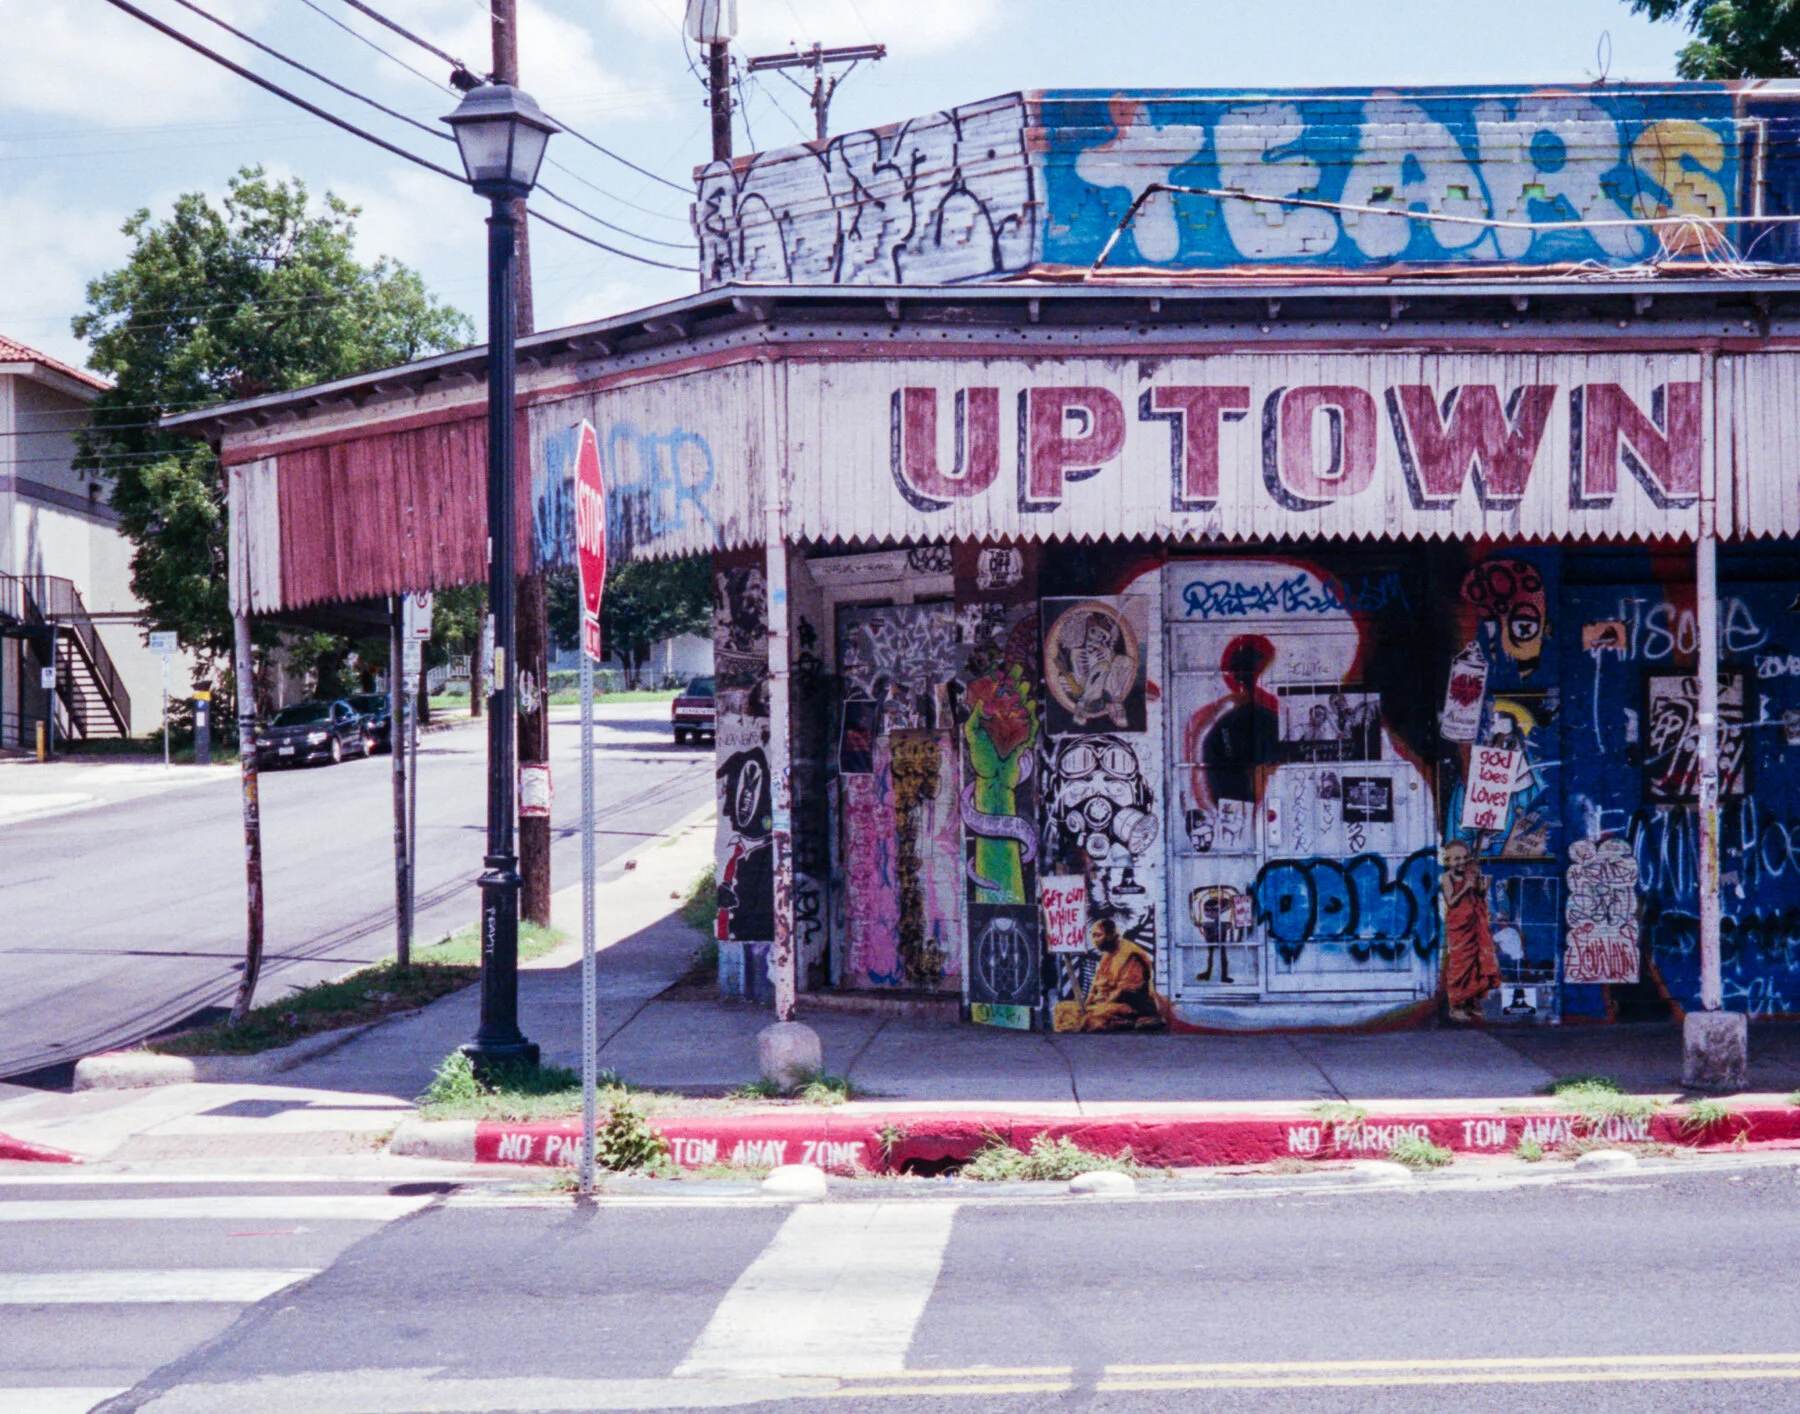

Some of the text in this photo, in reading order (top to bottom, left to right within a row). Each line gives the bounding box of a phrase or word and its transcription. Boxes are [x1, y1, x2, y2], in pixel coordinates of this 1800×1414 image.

[890, 382, 1701, 513] UPTOWN
[579, 480, 603, 558] STOP
[1041, 887, 1086, 909] GET OUT
[1048, 907, 1081, 930] WHILE
[1066, 926, 1086, 948] CAN
[497, 1133, 532, 1160] NO
[671, 1137, 718, 1164] TOW
[732, 1139, 789, 1166] AWAY
[801, 1140, 865, 1166] ZONE
[1287, 1126, 1320, 1153] NO
[1460, 1119, 1507, 1148] TOW
[1520, 1116, 1577, 1144] AWAY
[1590, 1115, 1654, 1144] ZONE
